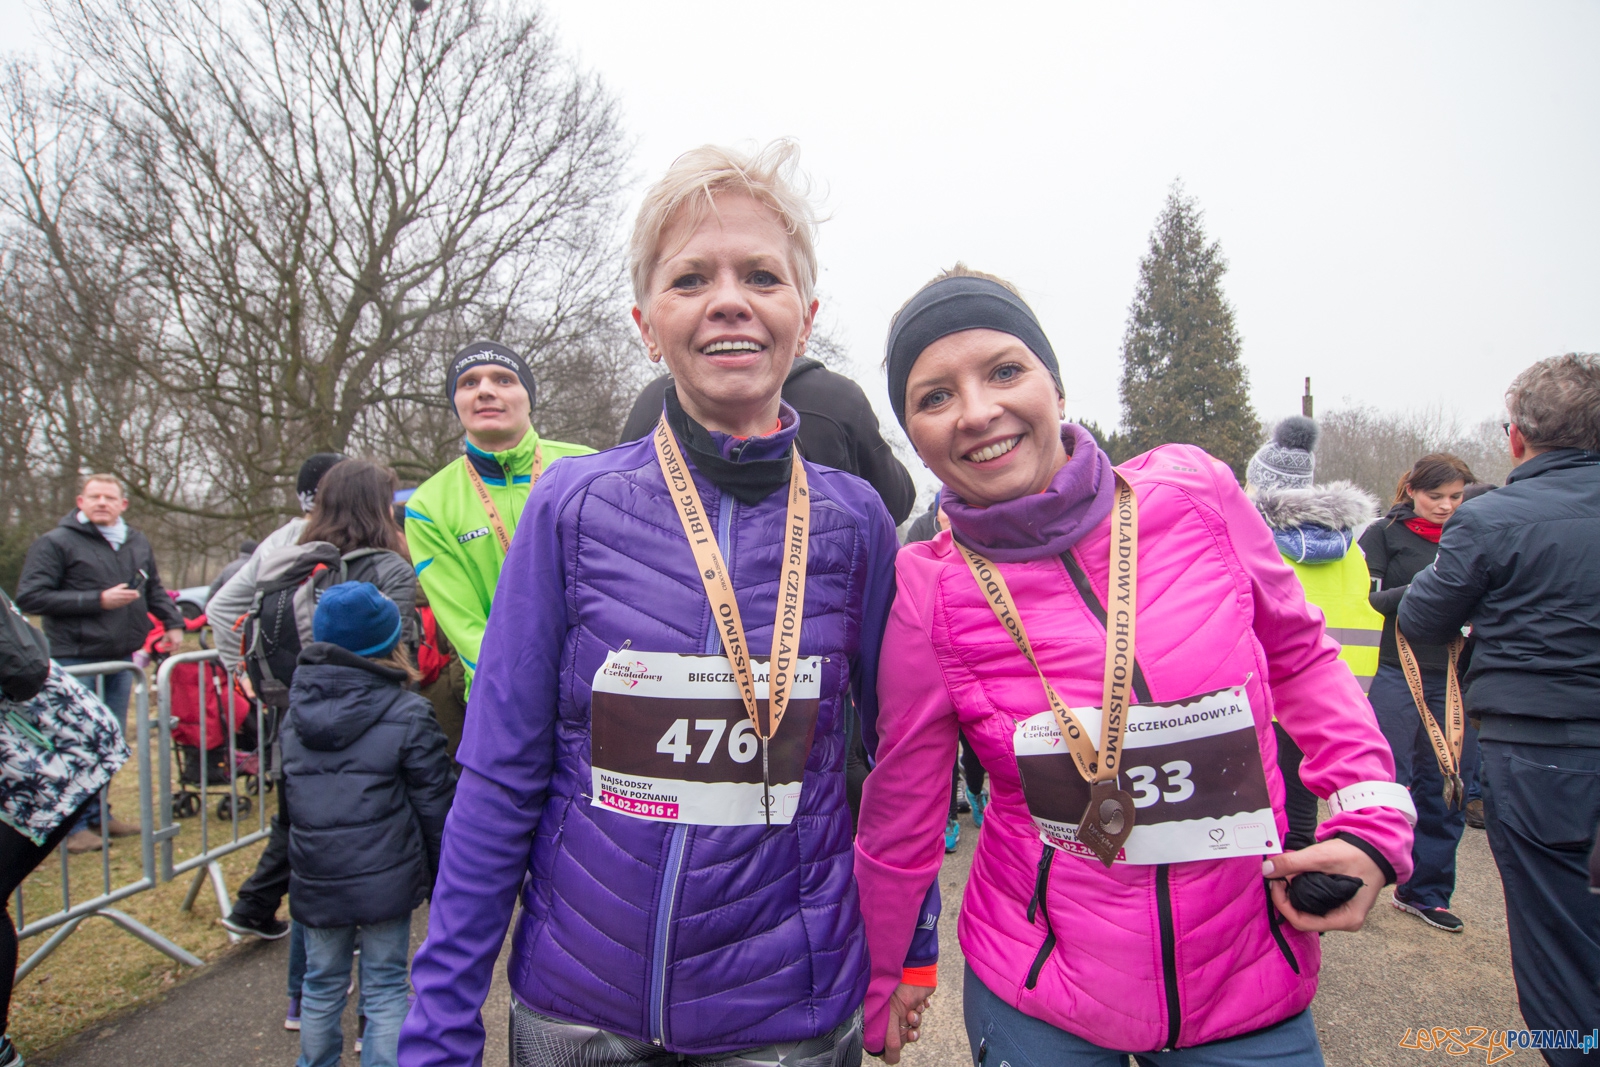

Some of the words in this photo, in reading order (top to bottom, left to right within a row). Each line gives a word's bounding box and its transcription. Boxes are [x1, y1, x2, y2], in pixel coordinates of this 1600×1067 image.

[681, 495, 705, 535] BIEG
[790, 524, 803, 566] BIEG
[774, 570, 799, 722] CZEKOLADOWY
[603, 668, 663, 682] Czekoladowy
[612, 662, 631, 672] Bieg
[1105, 610, 1130, 769] CHOCOLISSIMO
[656, 718, 758, 764] 476
[600, 774, 653, 790] NAJSŁODSZY
[601, 783, 618, 794] BIEG
[620, 789, 628, 797] W
[630, 791, 678, 803] POZNANIU
[602, 794, 664, 816] 14.02.2016
[667, 808, 677, 817] r.
